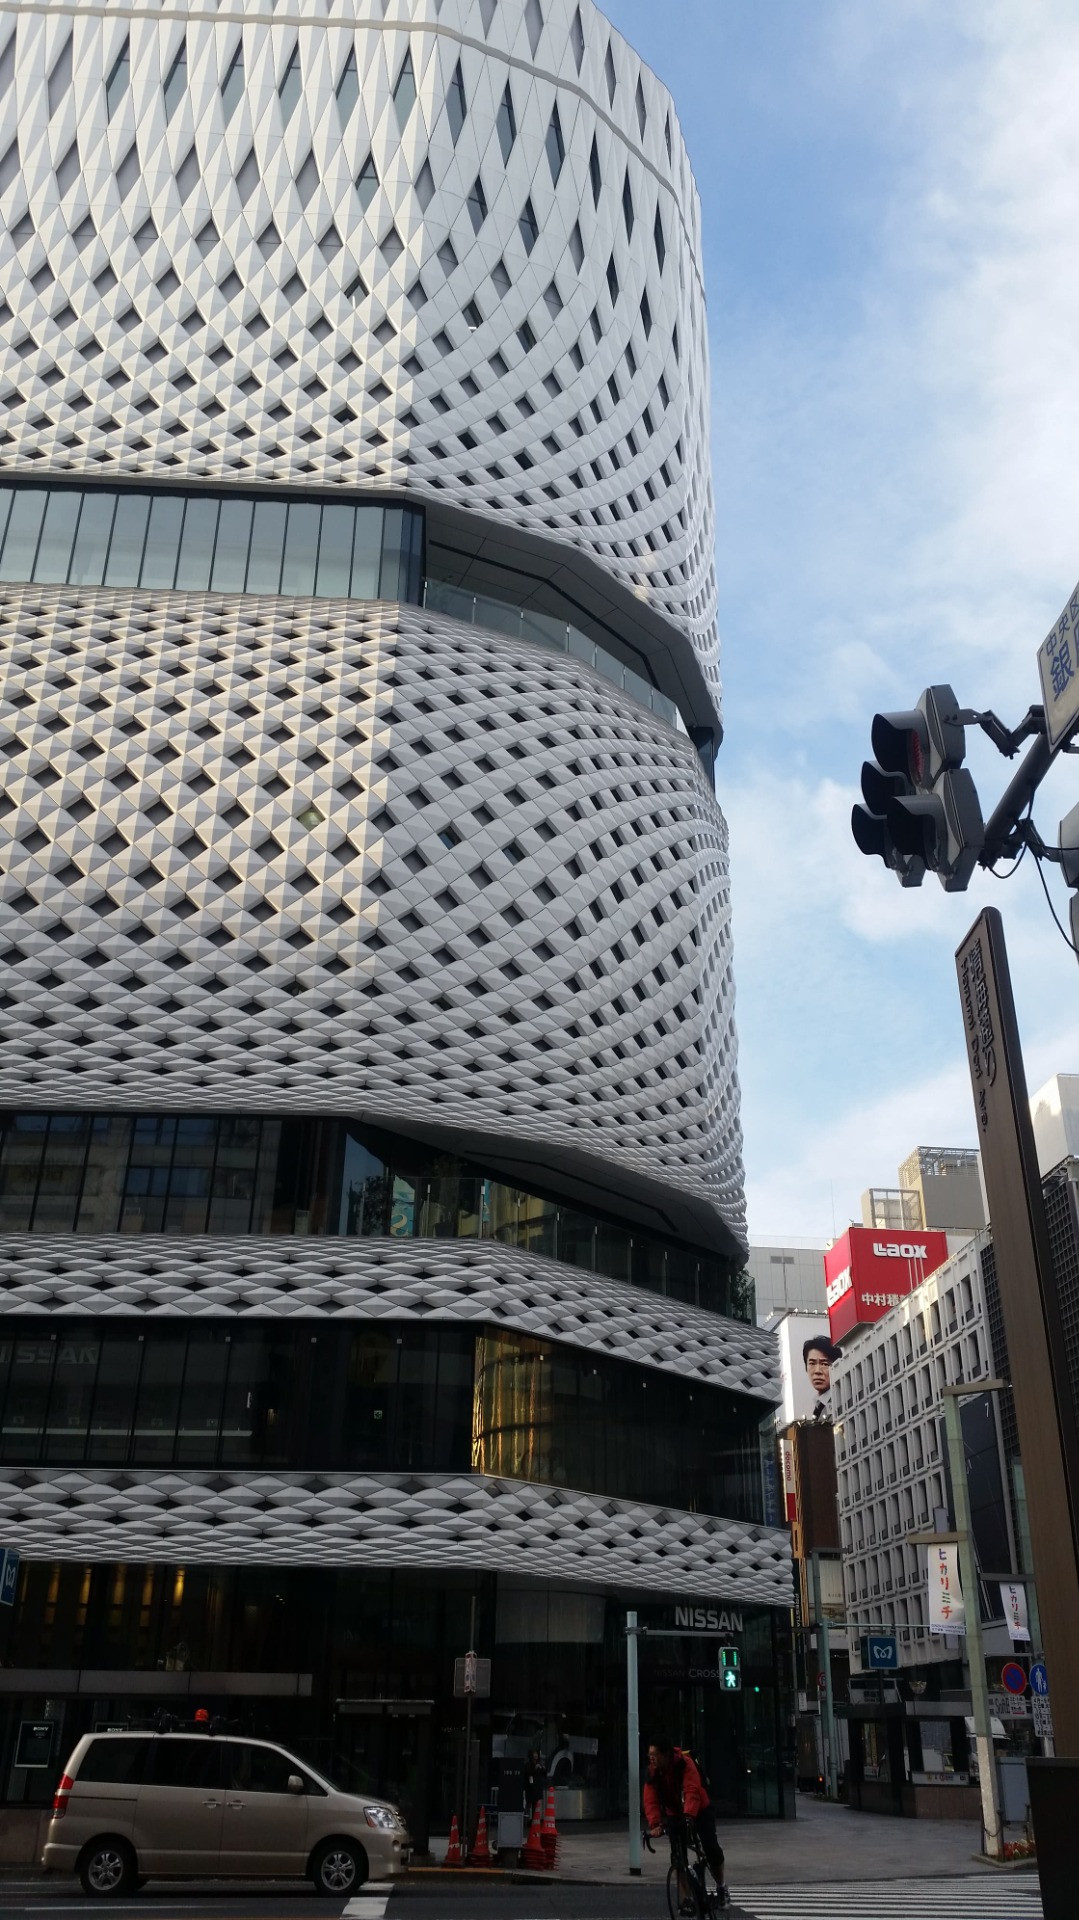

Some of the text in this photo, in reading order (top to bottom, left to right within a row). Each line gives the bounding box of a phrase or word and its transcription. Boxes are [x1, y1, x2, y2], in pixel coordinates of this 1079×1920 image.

[939, 1548, 952, 1620] ヒカリミチ
[674, 1606, 744, 1632] NISSAN
[1009, 1585, 1021, 1630] ヒカリミチ
